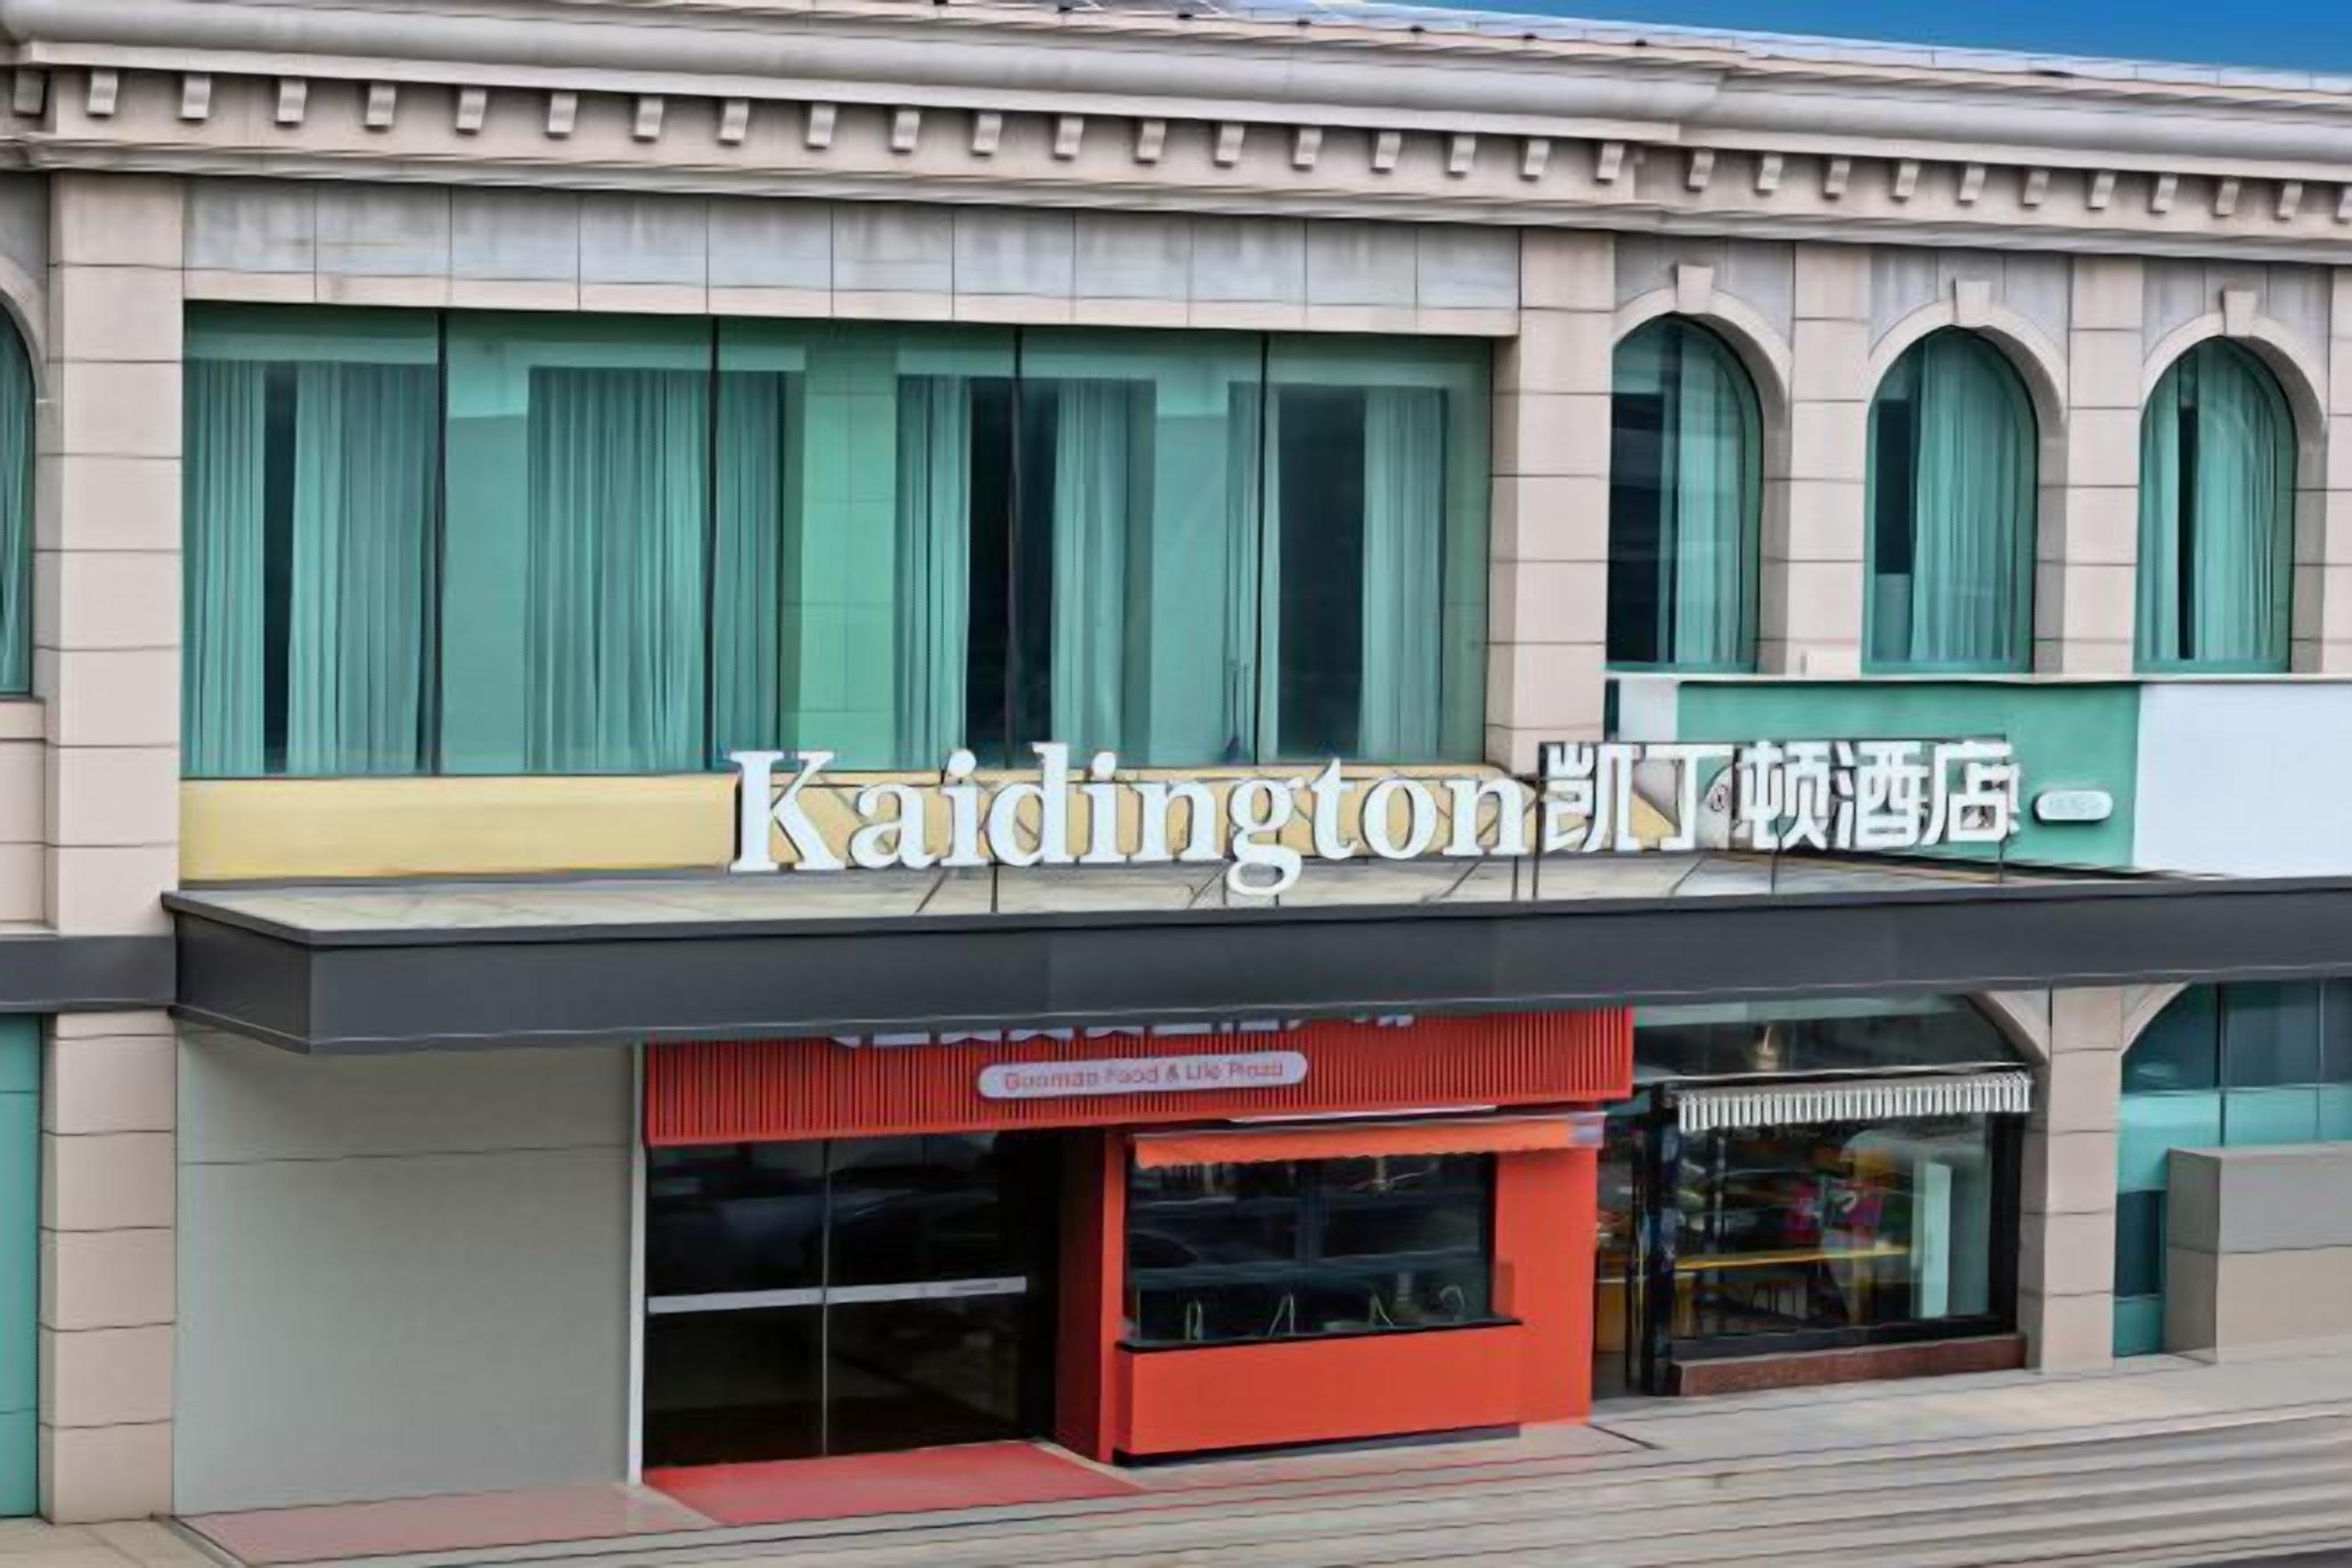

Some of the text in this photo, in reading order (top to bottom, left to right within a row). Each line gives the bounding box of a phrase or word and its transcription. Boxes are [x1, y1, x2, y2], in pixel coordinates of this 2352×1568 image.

[730, 741, 1528, 896] Kaidington
[1541, 739, 2019, 852] 凯丁顿酒店
[1106, 1065, 1157, 1084] Food
